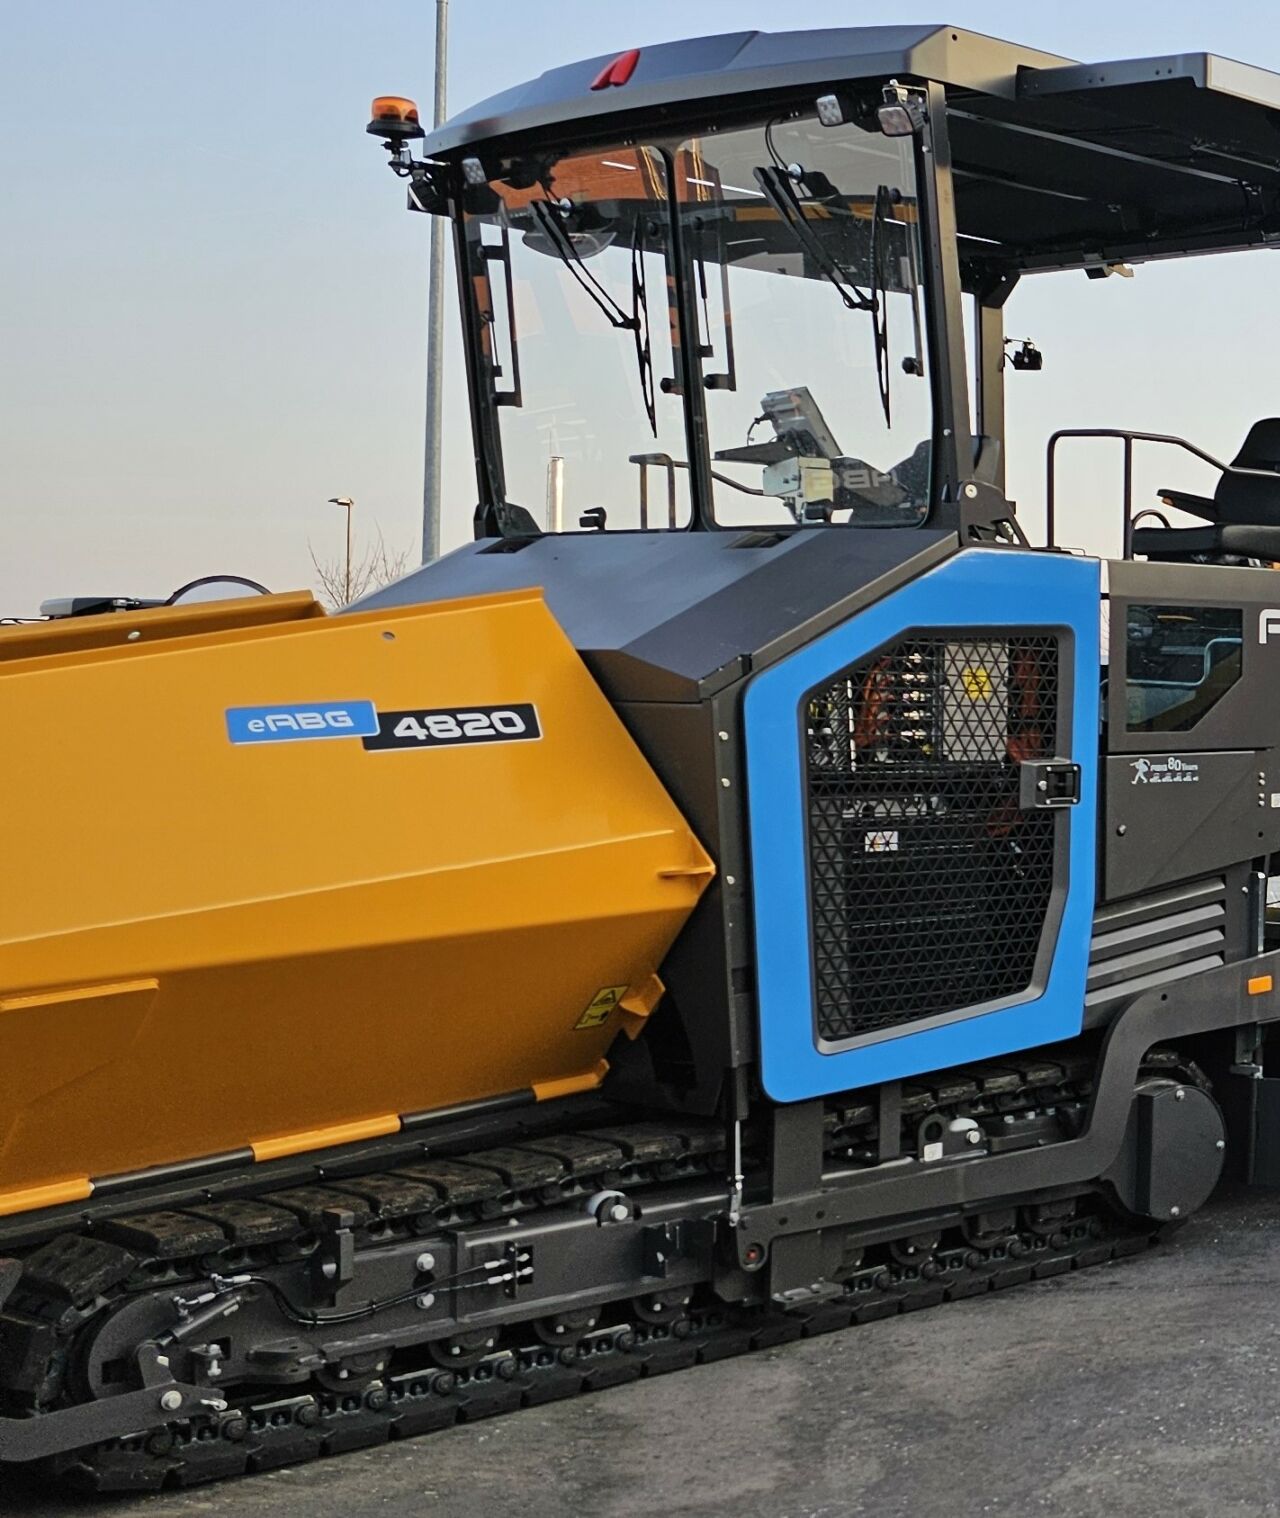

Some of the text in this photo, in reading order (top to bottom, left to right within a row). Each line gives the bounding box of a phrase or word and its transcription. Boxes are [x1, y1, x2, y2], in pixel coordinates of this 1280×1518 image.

[247, 710, 527, 740] eABG 4820
[1167, 757, 1181, 771] 80
